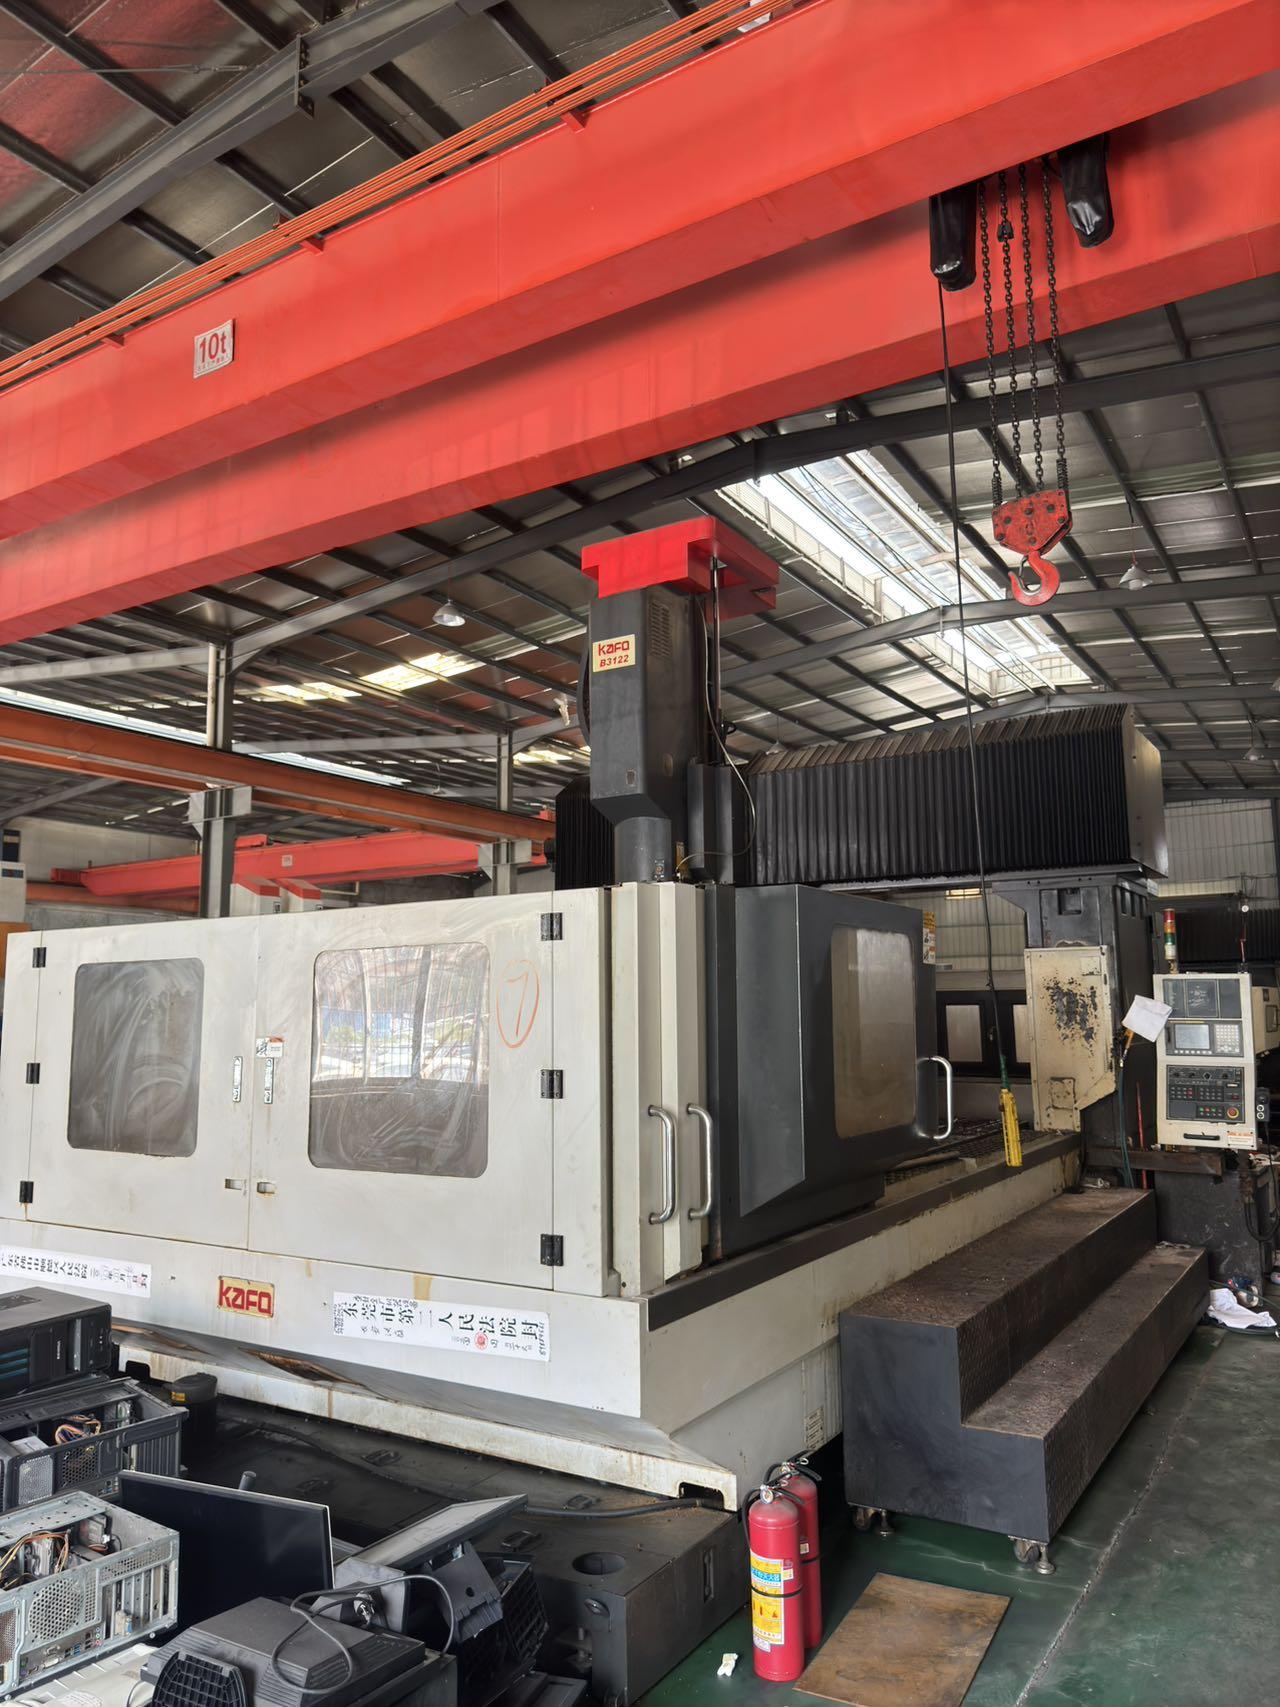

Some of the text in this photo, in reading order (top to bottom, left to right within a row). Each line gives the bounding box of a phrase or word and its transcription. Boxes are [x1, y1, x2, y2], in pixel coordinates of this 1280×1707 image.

[200, 331, 226, 363] 10t
[600, 655, 629, 667] B3122
[343, 1301, 539, 1340] 东莞市第二人民法院封
